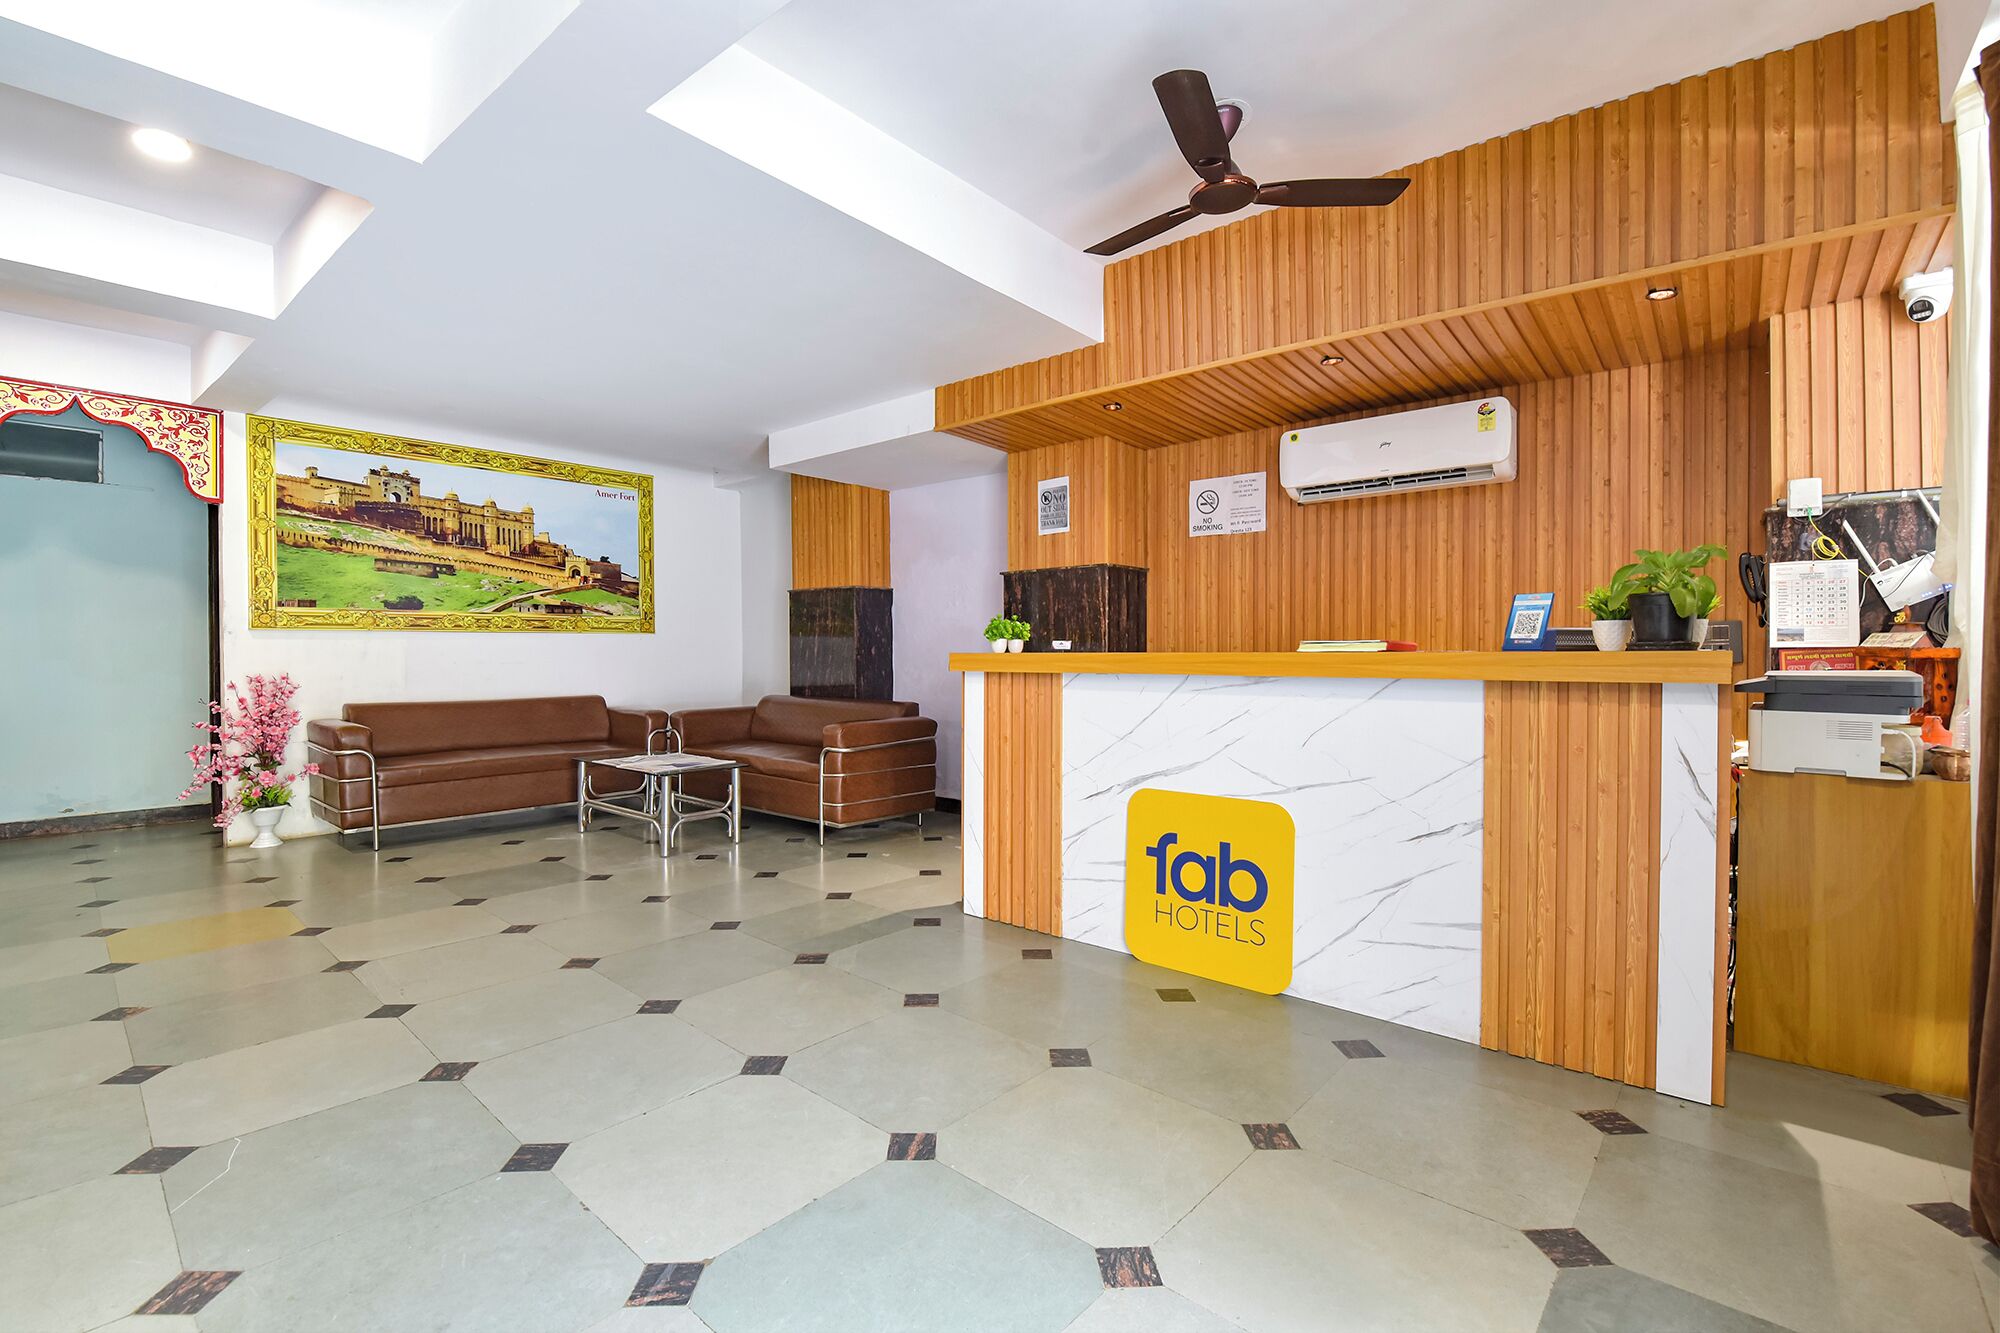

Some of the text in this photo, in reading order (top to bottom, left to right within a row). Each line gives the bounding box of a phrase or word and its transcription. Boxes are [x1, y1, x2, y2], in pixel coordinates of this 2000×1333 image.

[595, 489, 635, 501] Amer Fort
[1193, 524, 1223, 532] SMOKING
[1146, 832, 1268, 913] fab
[1155, 900, 1266, 946] HOTELS
